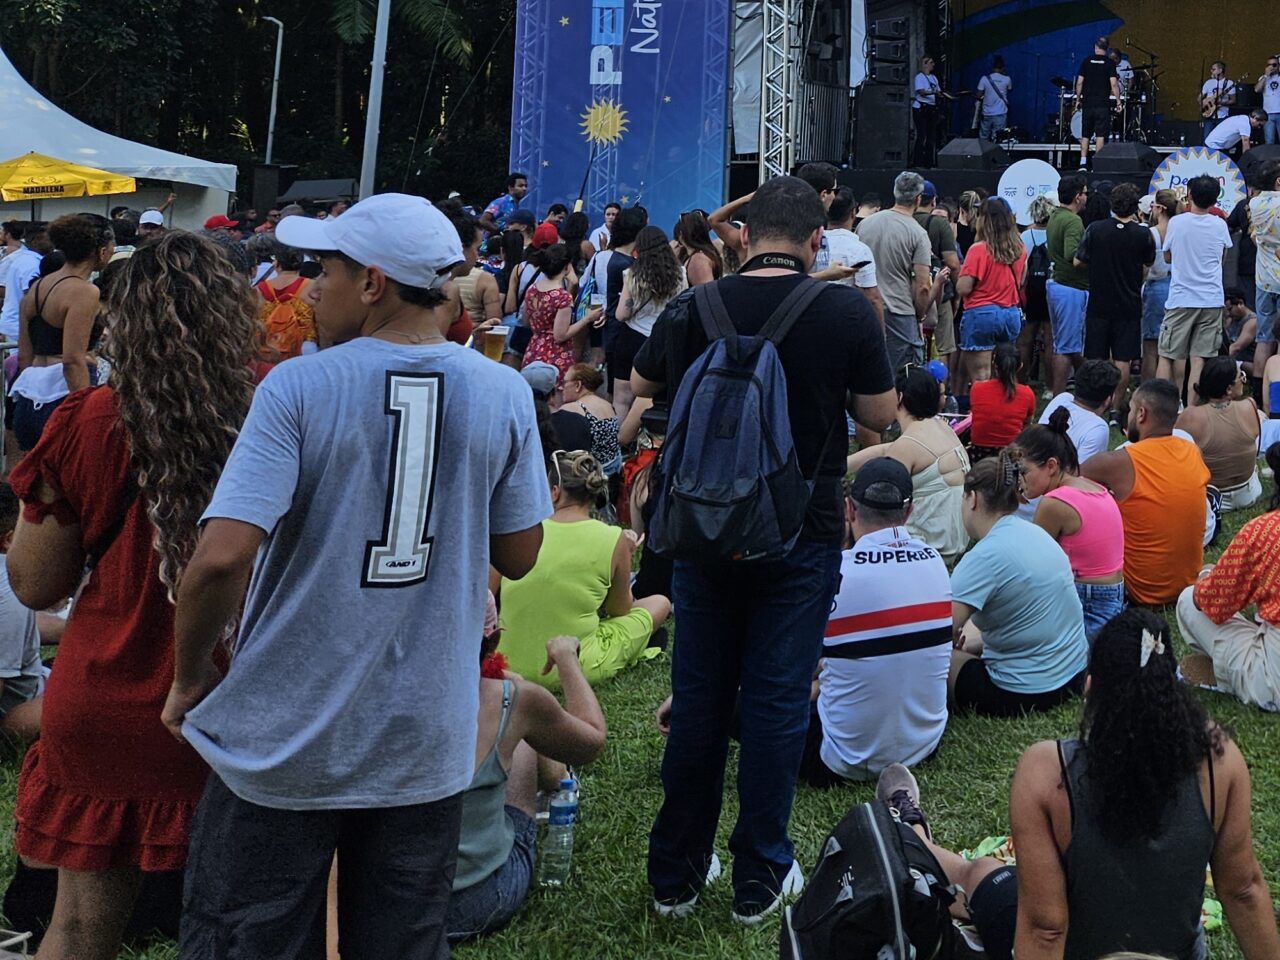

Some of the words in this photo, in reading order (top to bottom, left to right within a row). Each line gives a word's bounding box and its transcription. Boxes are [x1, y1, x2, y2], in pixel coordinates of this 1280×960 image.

[22, 185, 64, 194] MADALENA
[763, 256, 795, 267] Canon
[360, 370, 444, 588] 1
[854, 548, 938, 564] SUPERBE
